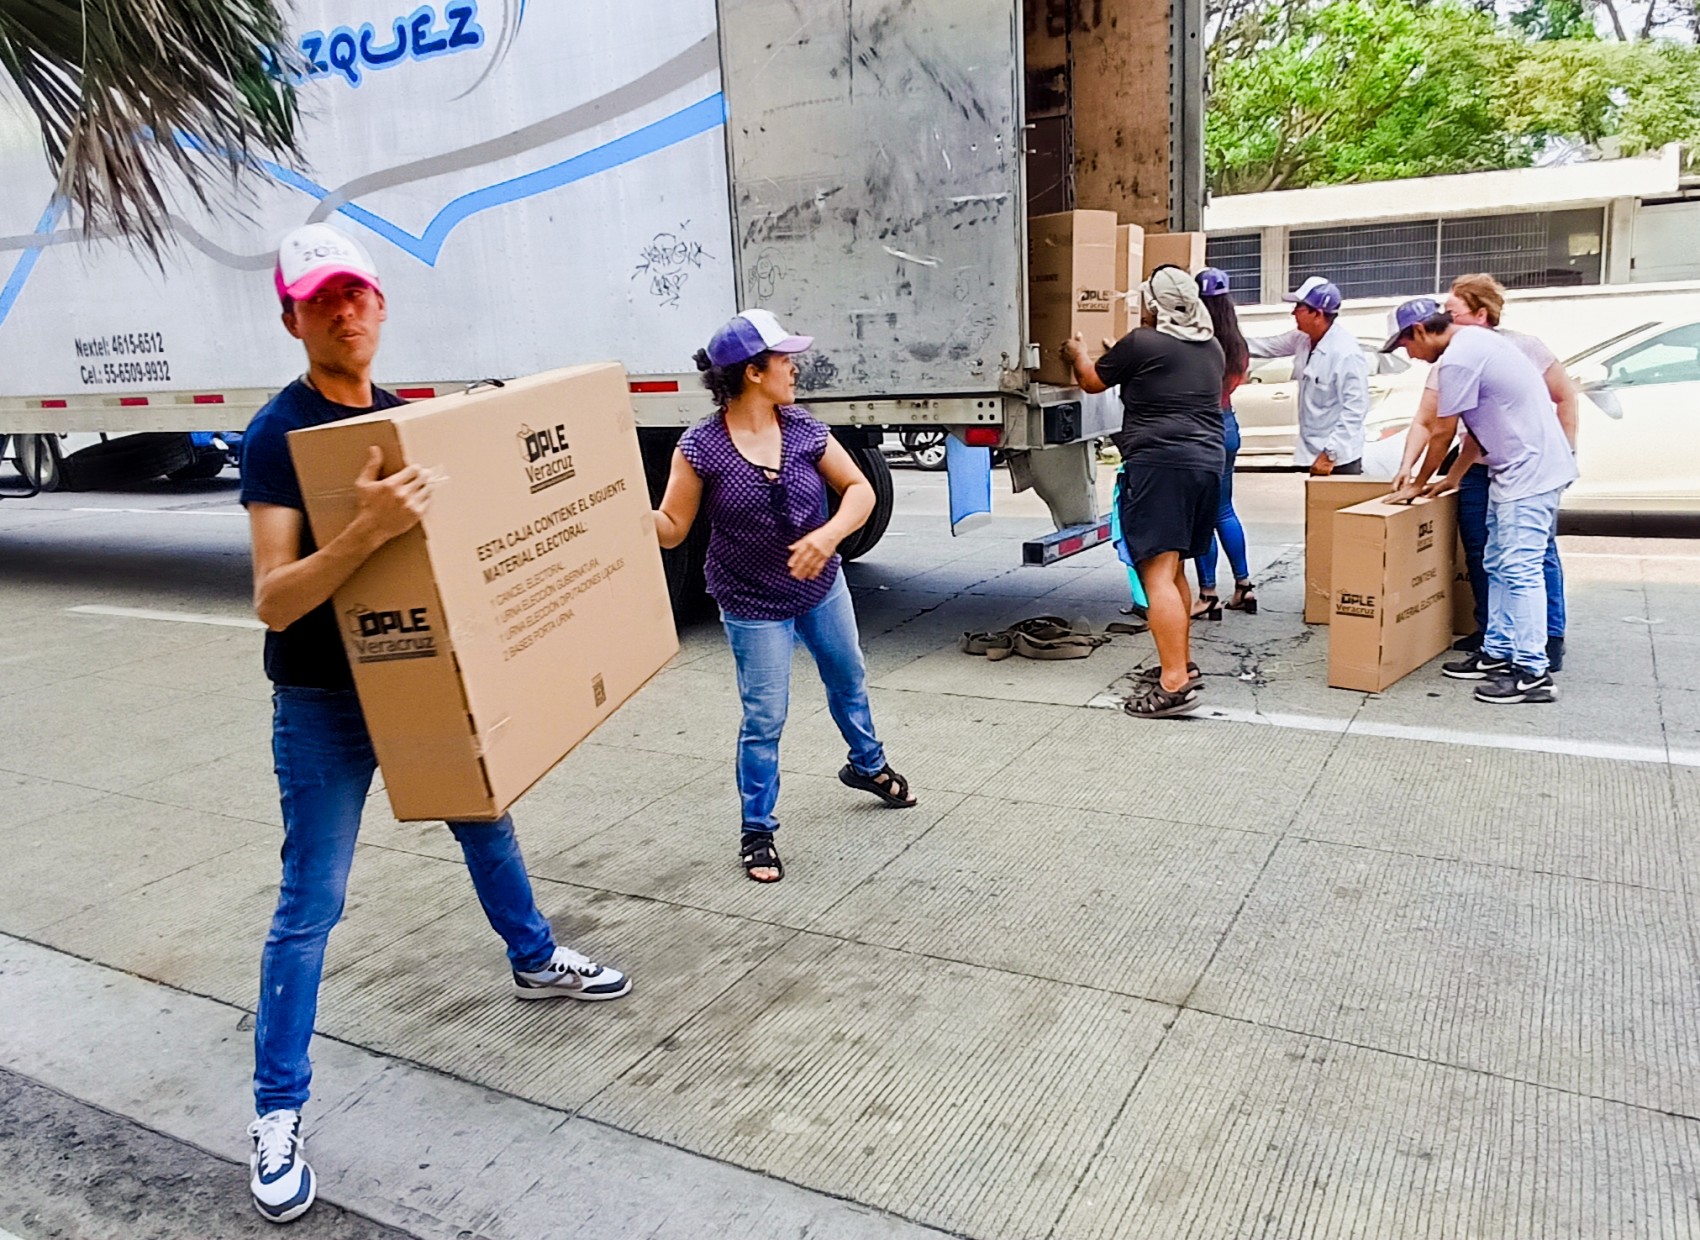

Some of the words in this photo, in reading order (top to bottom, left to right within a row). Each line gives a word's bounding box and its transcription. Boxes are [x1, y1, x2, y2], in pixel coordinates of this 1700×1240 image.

[74, 336, 111, 357] Nextel:
[112, 331, 164, 354] 4615-6512
[103, 360, 171, 384] 55-6509-9932
[523, 424, 570, 464] OPLE
[525, 455, 573, 483] Veracruz
[476, 538, 507, 563] ESTA
[505, 524, 534, 548] CAJA
[534, 501, 579, 535] CONTIENE
[577, 496, 590, 513] EL
[588, 478, 627, 507] SIGUIENTE
[482, 548, 536, 585] MATERIAL
[1336, 603, 1376, 615] Veracruz
[1341, 593, 1376, 607] OPLE
[358, 606, 432, 637] OPLE
[356, 636, 436, 654] Veracruz
